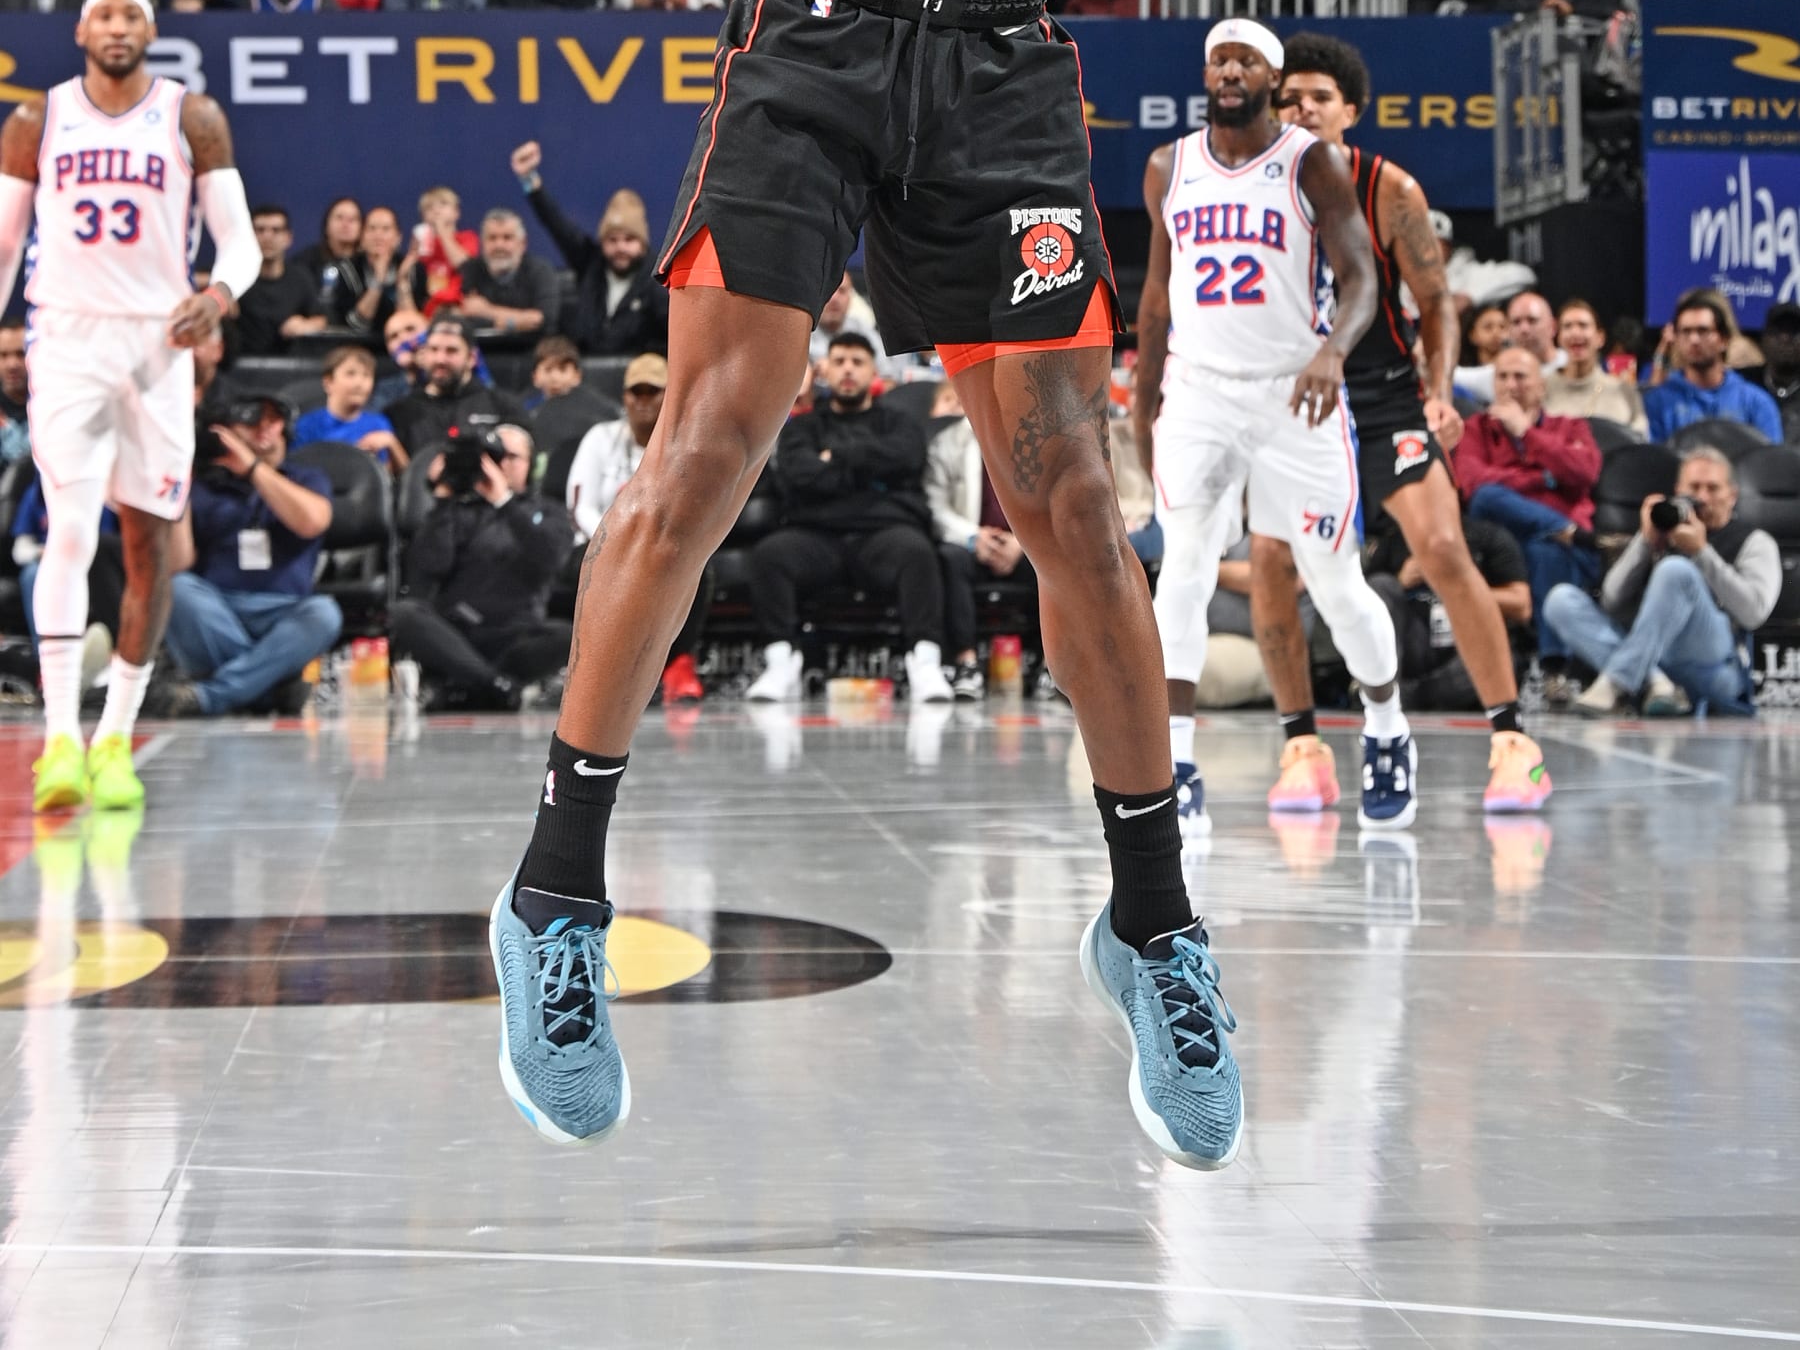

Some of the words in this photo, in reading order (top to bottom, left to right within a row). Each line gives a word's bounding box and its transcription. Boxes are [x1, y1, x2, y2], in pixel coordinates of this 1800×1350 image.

[1651, 96, 1800, 120] BETRIV
[55, 148, 165, 192] PHILA
[74, 199, 141, 245] 33
[1009, 207, 1082, 236] PISTONS
[1172, 203, 1287, 253] PHILA
[1010, 258, 1084, 306] Detroit
[1195, 254, 1265, 307] 22
[1302, 510, 1335, 540] 76
